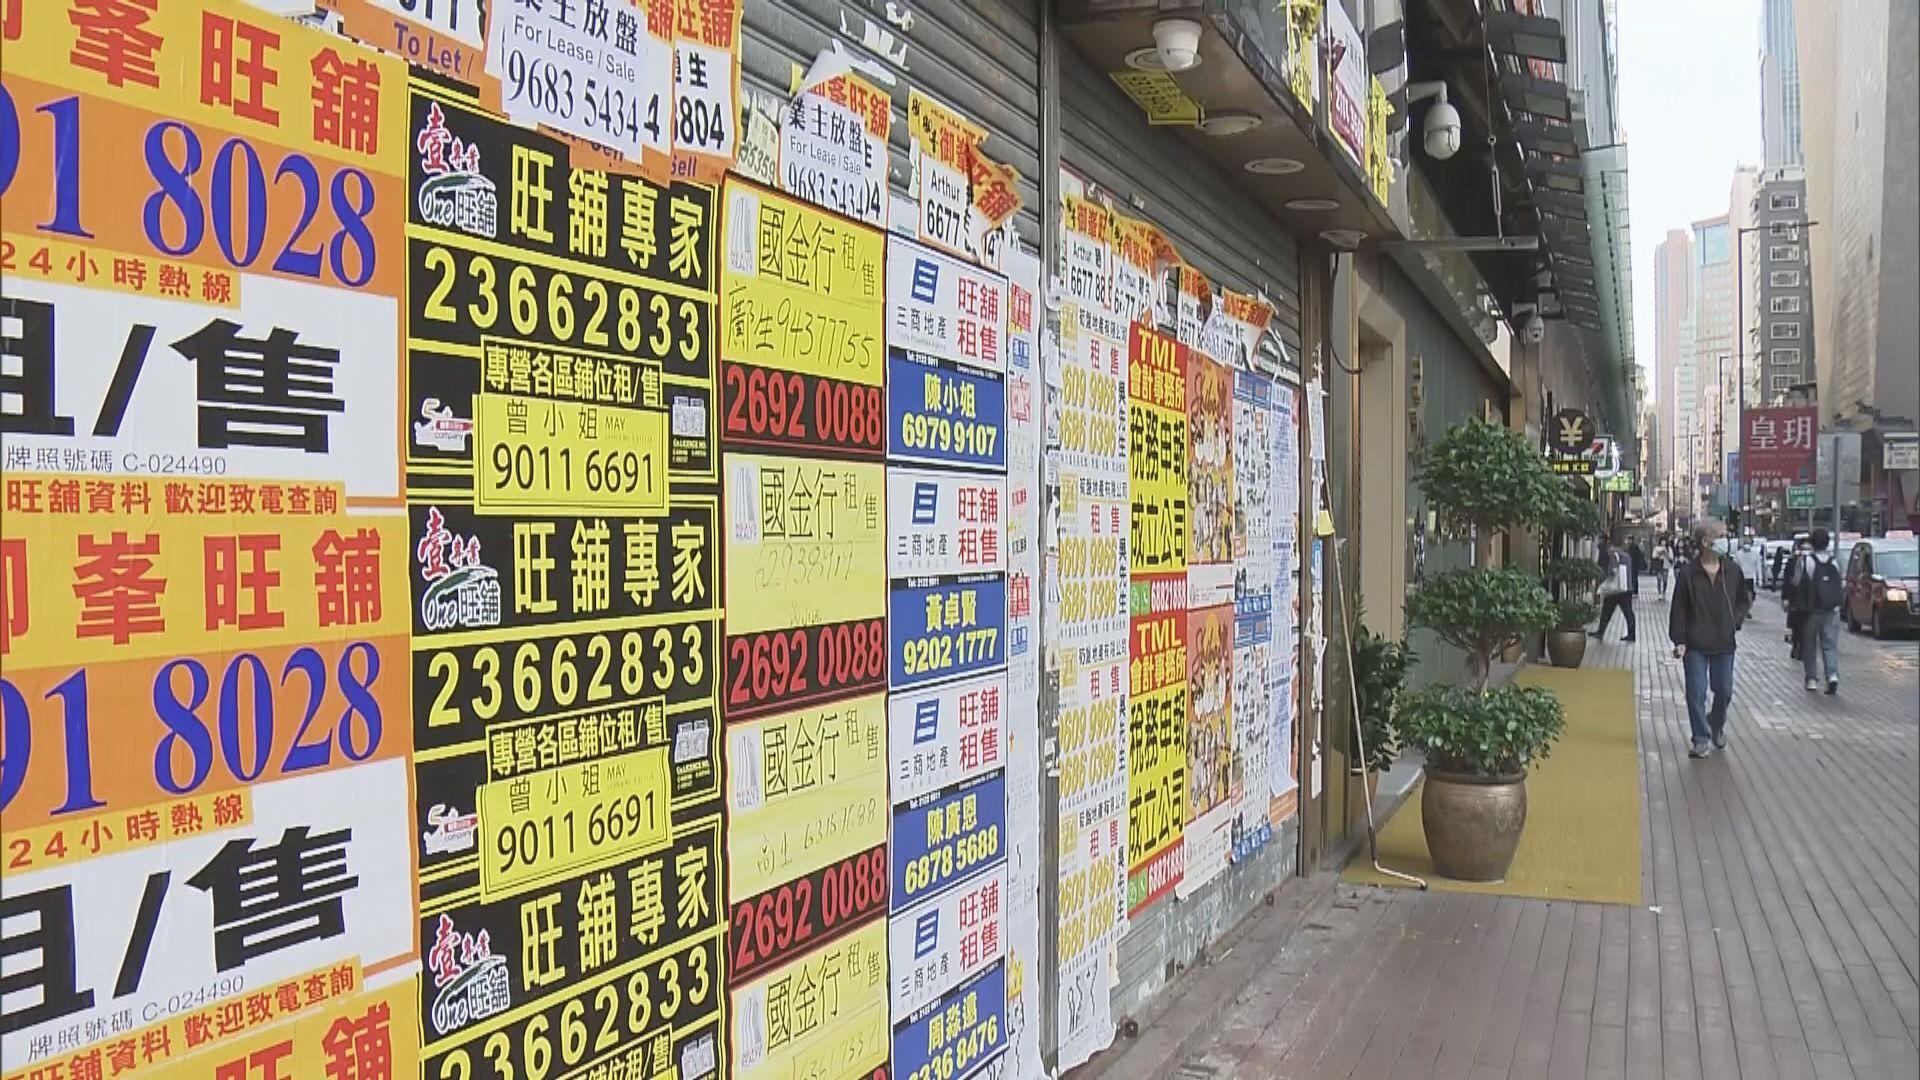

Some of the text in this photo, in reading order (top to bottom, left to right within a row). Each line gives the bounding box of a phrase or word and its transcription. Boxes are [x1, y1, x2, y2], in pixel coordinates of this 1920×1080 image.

[394, 21, 419, 55] To
[428, 38, 460, 75] Let
[514, 15, 542, 46] For
[547, 33, 593, 65] Lease
[605, 56, 635, 83] Sale
[0, 0, 381, 155] 峯旺舖
[508, 50, 574, 119] 9683
[584, 80, 639, 143] 5434
[788, 96, 864, 155] 業主放盤
[789, 135, 861, 175] For Lease Sale
[142, 119, 376, 288] 8028
[788, 162, 825, 205] 9683
[931, 169, 959, 202] Arthur
[420, 186, 498, 238] One 旺舖
[511, 143, 702, 280] 旺舖專家
[926, 199, 960, 247] 6677
[0, 239, 232, 304] 24小時熱線
[759, 201, 876, 297] 國金行 租/售
[424, 246, 700, 361] 23662833
[957, 275, 999, 325] 旺舖
[1071, 266, 1093, 299] 6677
[897, 304, 947, 341] 三商地產
[956, 318, 999, 364] 租售
[1090, 337, 1119, 376] 租售
[1138, 329, 1181, 376] TML
[727, 364, 881, 446] 2692 0088
[923, 372, 977, 419] 陳小姐
[1060, 363, 1086, 409] 609
[1129, 359, 1185, 411] 會計事務所
[507, 398, 626, 440] 曾小姐 MAY
[902, 414, 997, 457] 6979 9107
[1749, 415, 1812, 451] 皇玥
[5, 445, 228, 475] 牌照號碼 C-024490
[492, 442, 653, 494] 9011 6691
[1130, 405, 1186, 487] 稅務申報
[164, 483, 337, 514] 歡迎致電查詢
[760, 466, 878, 542] 國金行 租/售
[957, 487, 999, 525] 旺舖
[1090, 503, 1120, 536] 租售
[897, 533, 948, 556] 三商地產
[957, 527, 999, 566] 租售
[1131, 491, 1186, 568] 成立公司
[0, 527, 383, 653] 峯旺舖
[512, 519, 706, 614] 旺舖專家
[421, 580, 501, 630] One 旺舖
[1151, 578, 1186, 614] 68821888
[903, 634, 952, 675] 9202
[955, 628, 998, 665] 1777
[1137, 617, 1181, 655] TML
[427, 624, 704, 728] 23662833
[730, 620, 884, 705] 2692 0088
[1090, 664, 1120, 700] 租售
[1129, 648, 1186, 695] 會計事務所
[153, 641, 383, 795] 8028
[958, 685, 999, 729] 旺舖
[1129, 688, 1186, 776] 稅務申報
[763, 707, 879, 801] 國金行 租/售
[900, 745, 949, 780] 三商地產
[958, 726, 999, 772] 租售
[509, 762, 627, 814] 曾小姐 MAY
[9, 793, 245, 869] 24小時熱線
[497, 789, 655, 873] 9011 6691
[1089, 817, 1119, 859] 租售
[1128, 767, 1185, 864] 成立公司
[904, 824, 998, 891] 6878 5688
[520, 845, 710, 992] 旺舖專家
[735, 847, 885, 971] 2692 0088
[958, 880, 999, 931] 旺舖
[958, 922, 999, 973] 租售
[432, 965, 511, 1034] One 旺舖
[767, 951, 841, 1055] 國金行
[847, 940, 880, 988] 租/售
[900, 951, 949, 999] 三商地產
[27, 975, 245, 1062] 牌照號碼 C-024490
[184, 964, 354, 1048] 歡迎致電查詢
[956, 1014, 998, 1070] 8476
